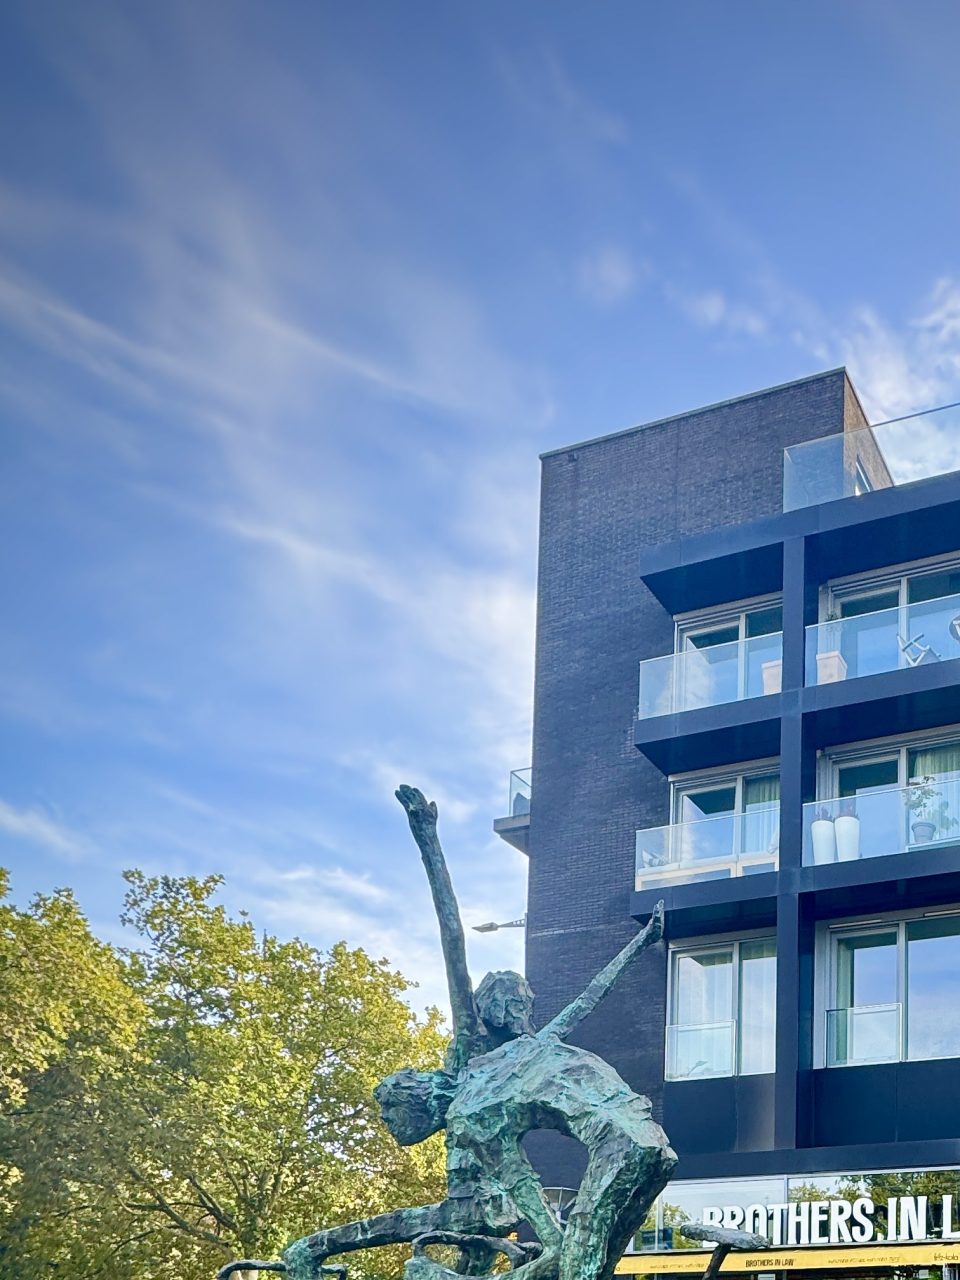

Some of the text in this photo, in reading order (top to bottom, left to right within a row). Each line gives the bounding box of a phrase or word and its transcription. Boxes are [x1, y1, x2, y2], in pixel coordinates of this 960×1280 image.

[703, 1198, 875, 1247] BROTHERS
[887, 1195, 928, 1241] IN
[746, 1258, 794, 1267] BROTHERS IN LAW
